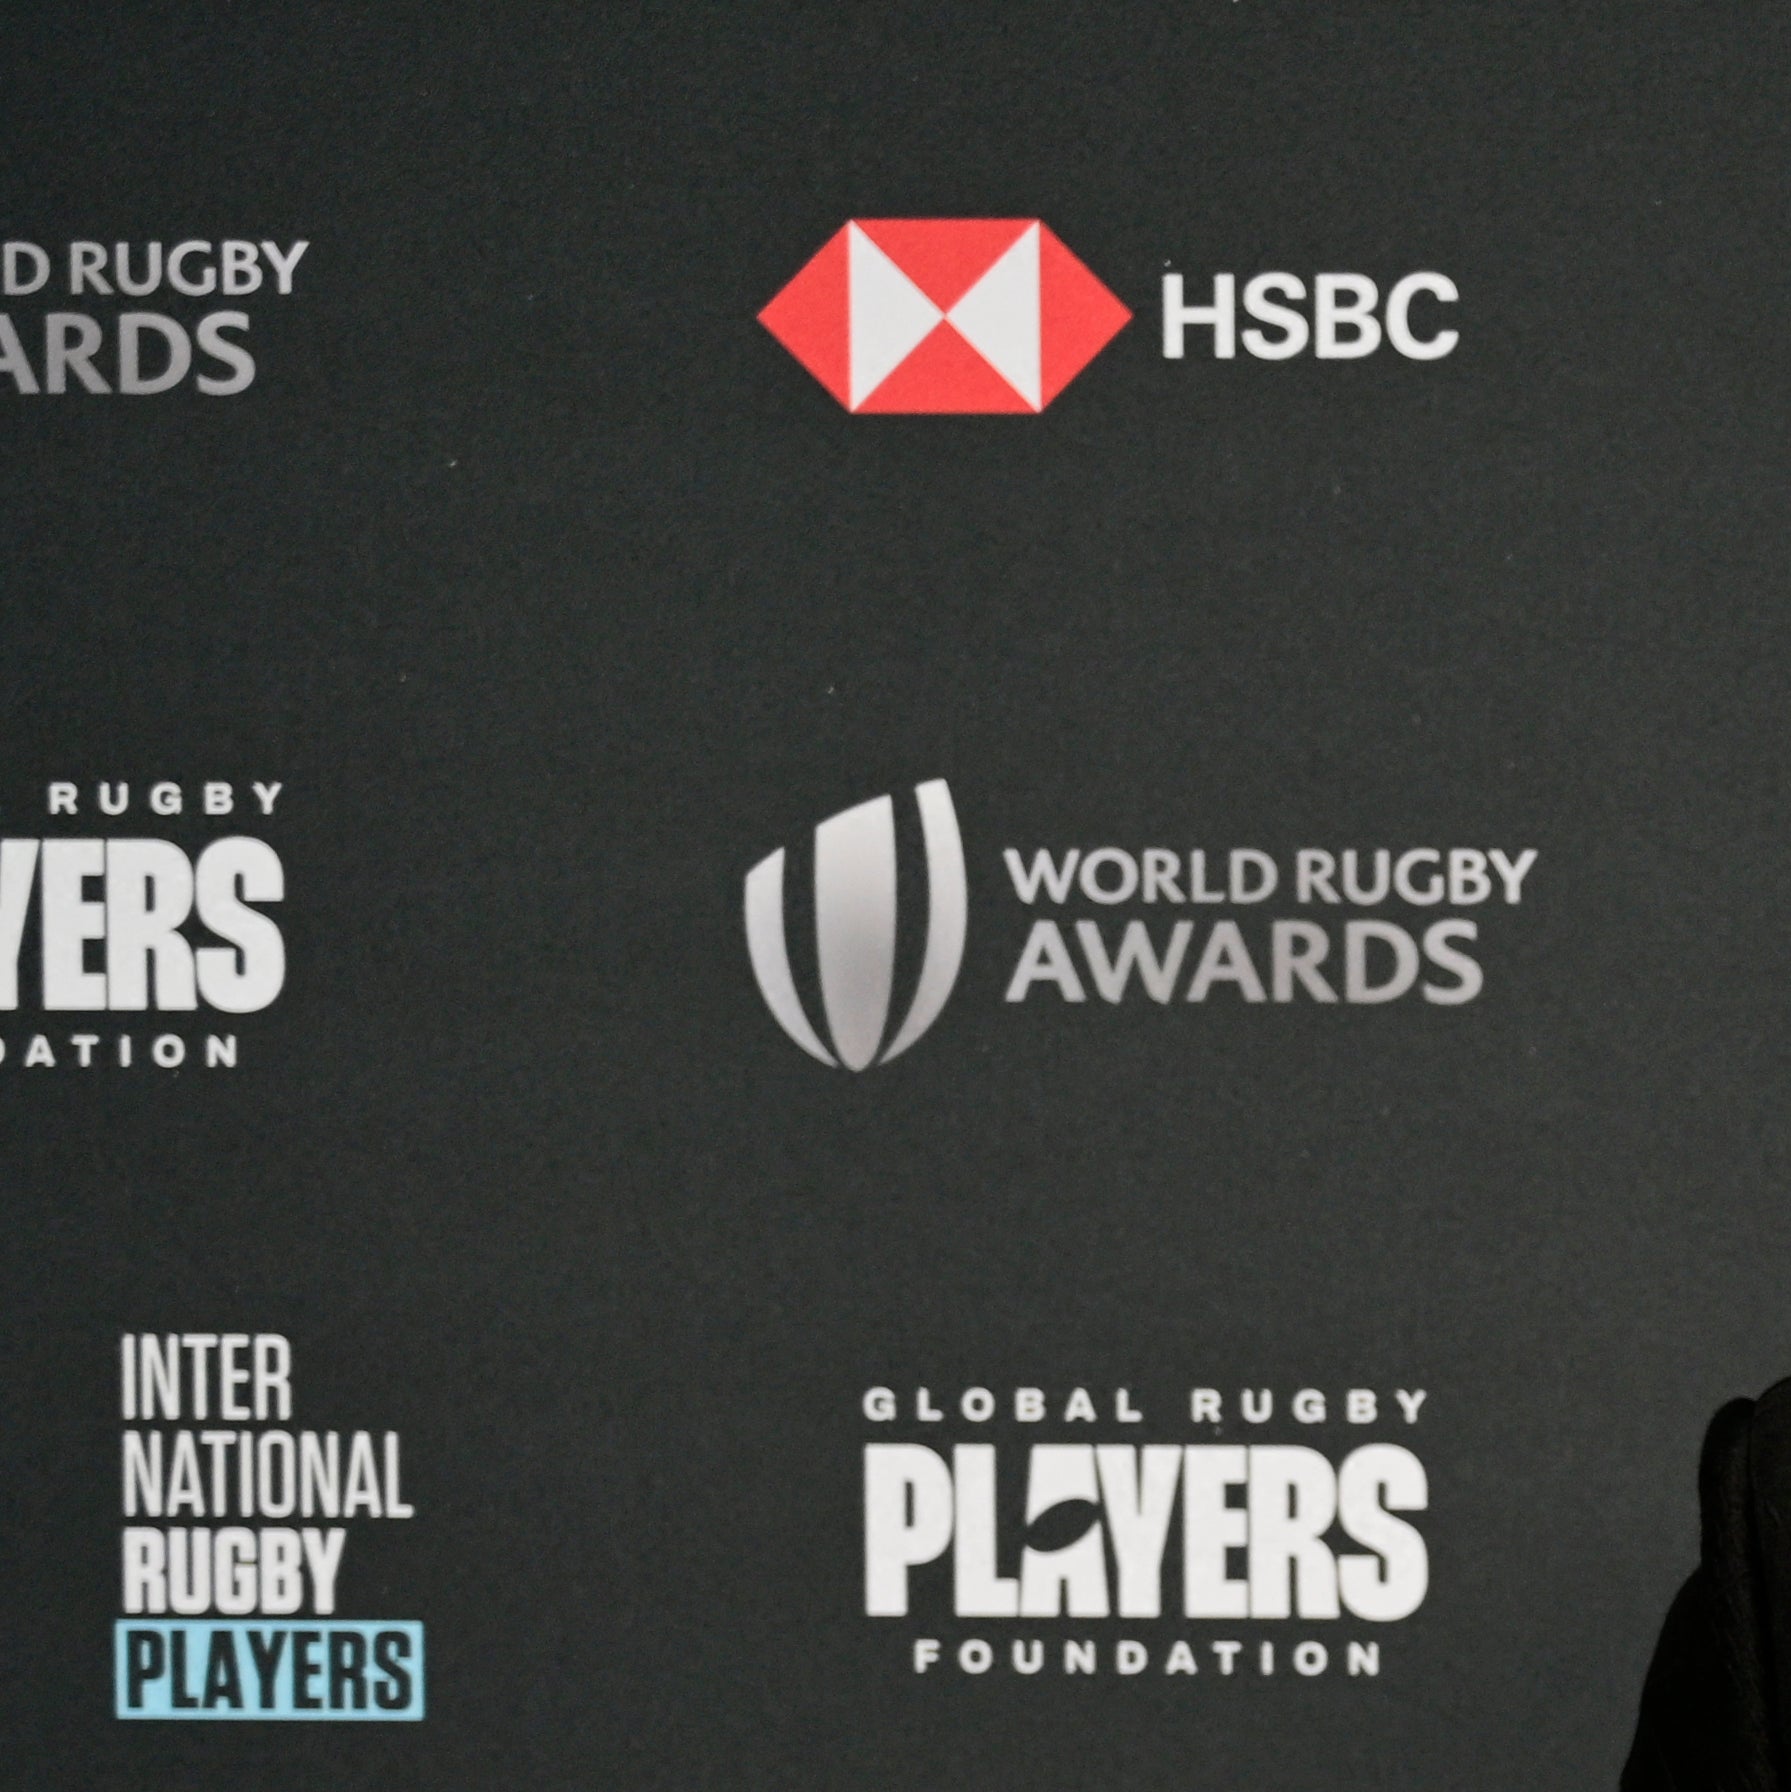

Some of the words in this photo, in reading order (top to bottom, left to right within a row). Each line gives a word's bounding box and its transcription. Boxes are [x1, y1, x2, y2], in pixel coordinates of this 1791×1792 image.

[71, 240, 308, 295] RUGBY
[1163, 272, 1458, 360] HSBC
[49, 782, 281, 815] RUGBY
[1004, 848, 1277, 904] WORLD
[1297, 849, 1537, 905] RUGBY
[1006, 919, 1482, 1004] AWARDS
[122, 1334, 291, 1420] INTER
[863, 1387, 1142, 1422] GLOBAL
[1192, 1389, 1425, 1423] RUGBY
[123, 1430, 414, 1518] NATIONAL
[123, 1527, 345, 1614] RUGBY
[865, 1444, 1428, 1621] PLAYERS
[127, 1630, 412, 1711] PLAYERS
[914, 1639, 1379, 1676] FOUNDATION
